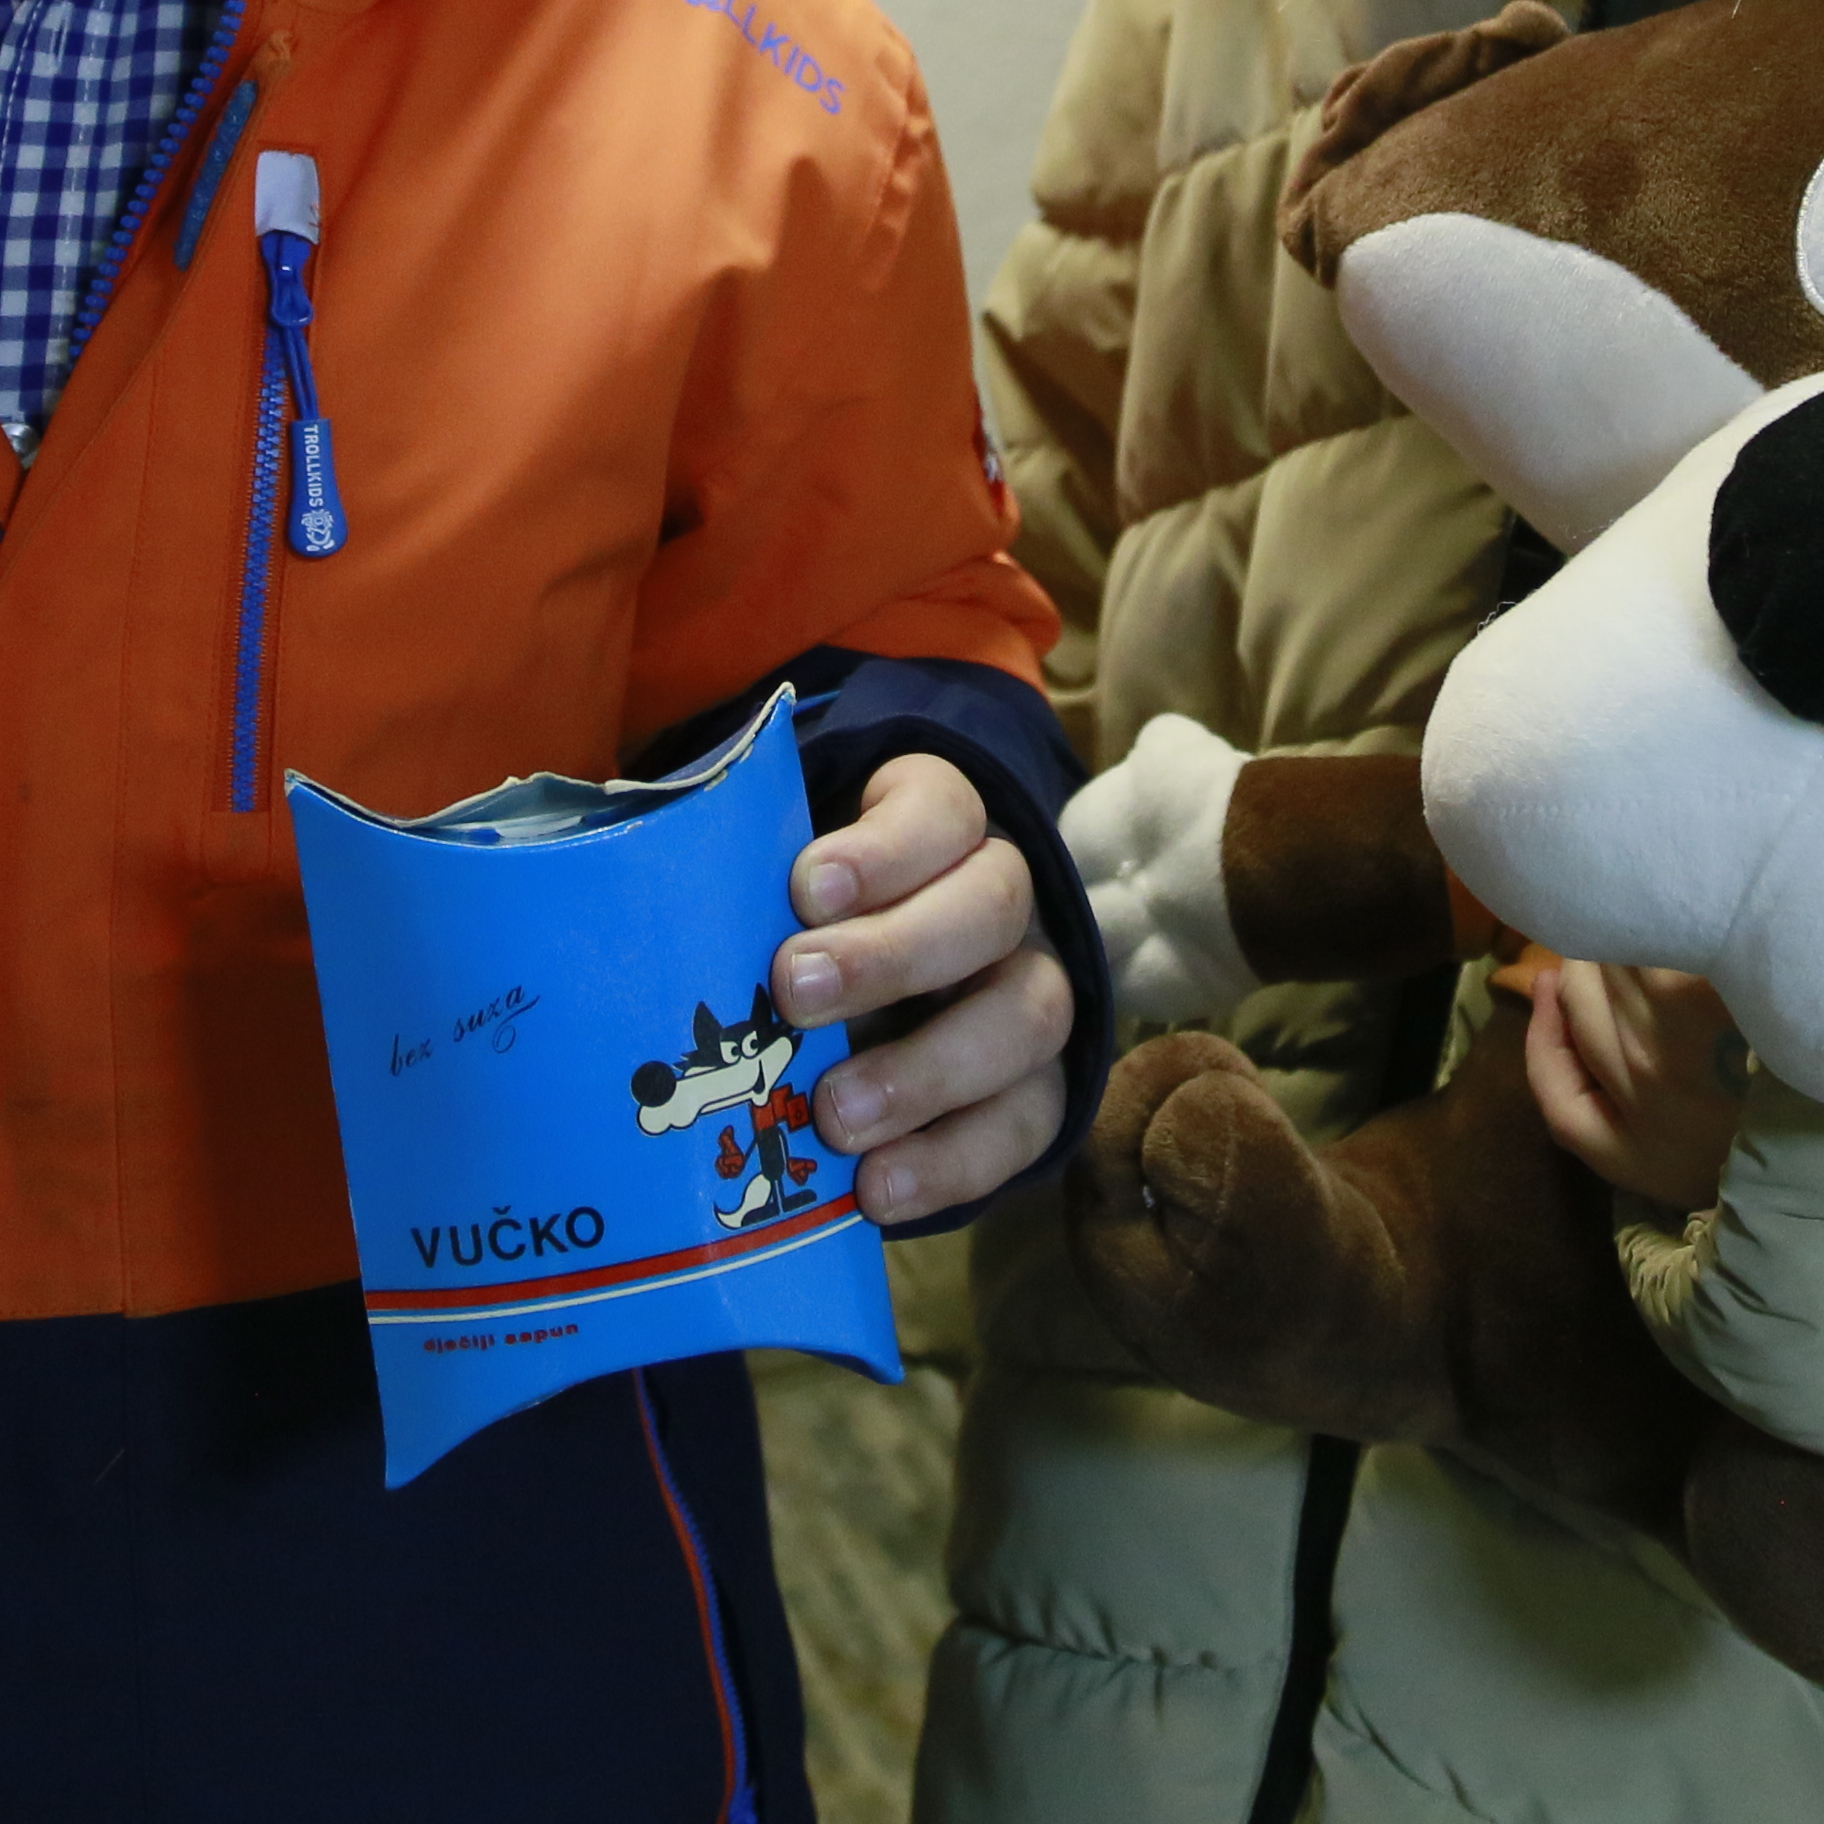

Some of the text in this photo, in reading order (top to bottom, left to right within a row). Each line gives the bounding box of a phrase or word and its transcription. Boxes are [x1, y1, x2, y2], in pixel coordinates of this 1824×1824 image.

[303, 423, 324, 508] TROLLKIDS
[390, 983, 540, 1078] bez suza
[410, 1205, 606, 1269] VUČKO
